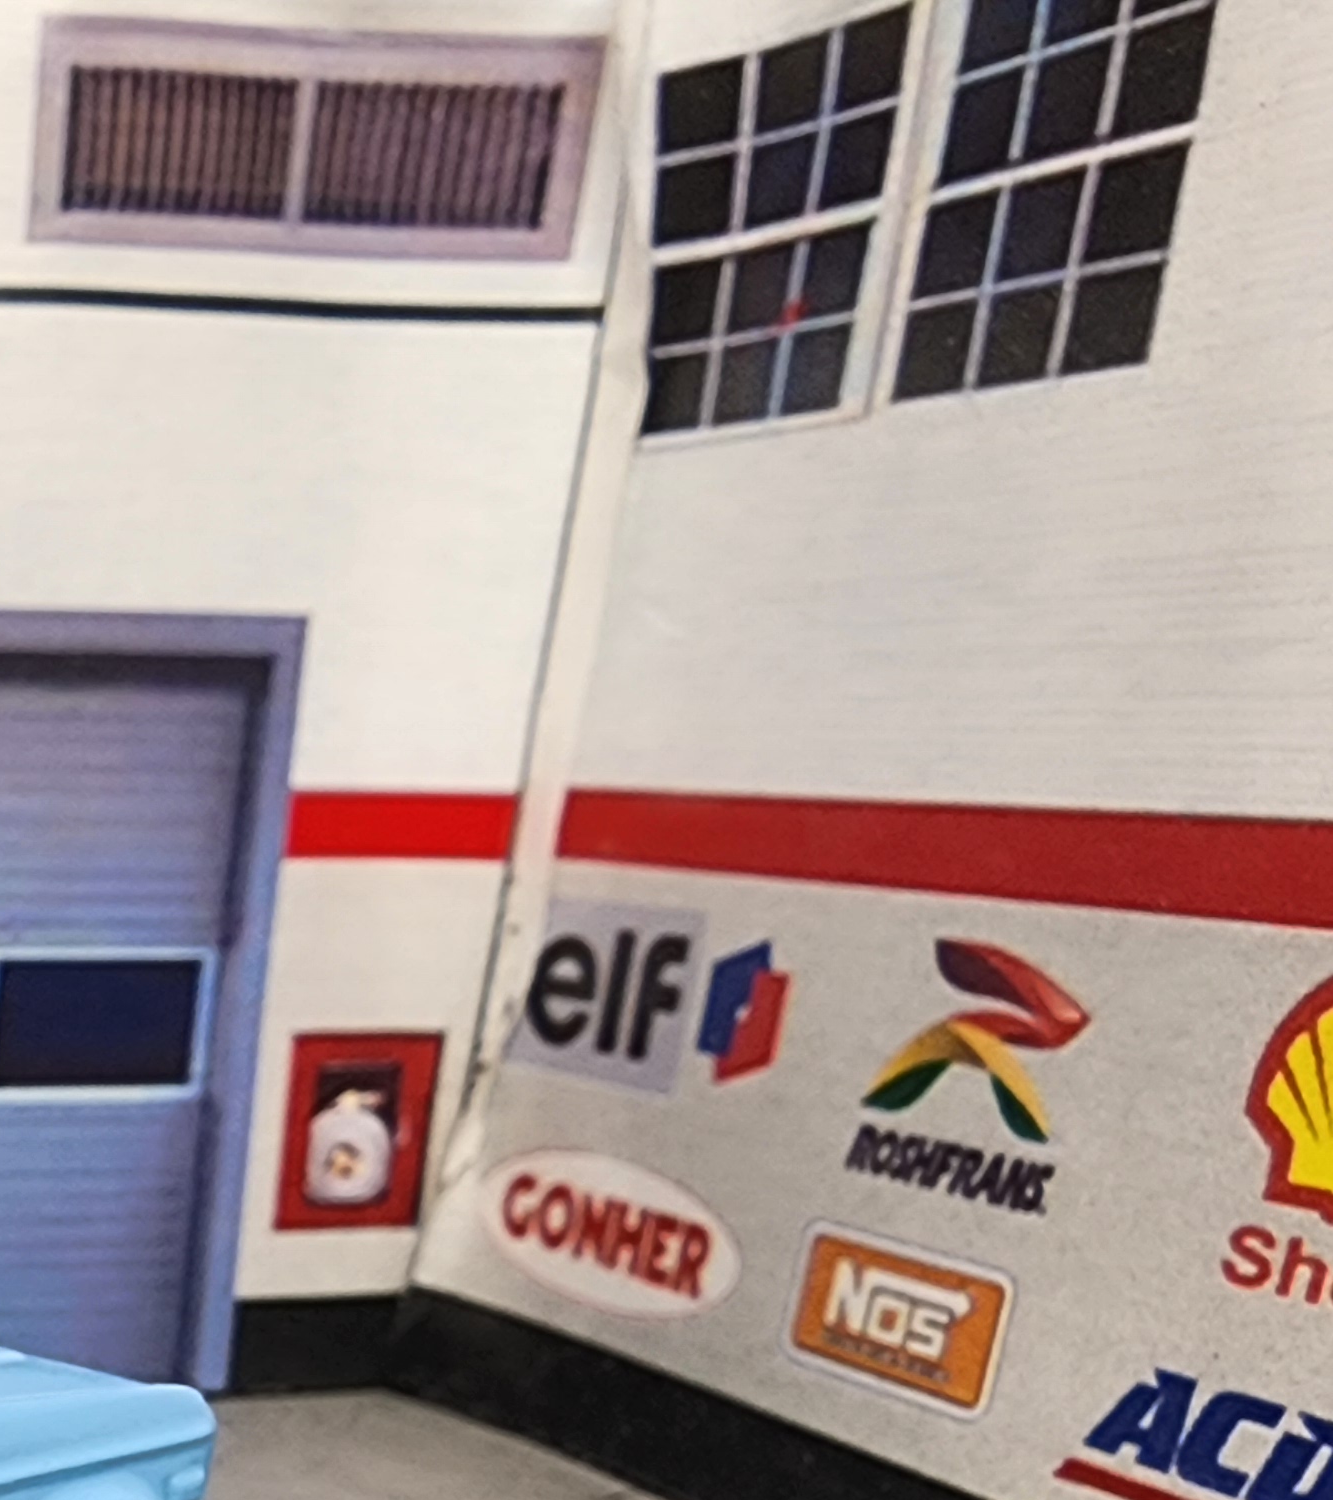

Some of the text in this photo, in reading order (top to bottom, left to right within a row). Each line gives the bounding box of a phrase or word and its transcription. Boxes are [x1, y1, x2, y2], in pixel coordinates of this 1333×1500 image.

[527, 930, 689, 1059] elf
[845, 1124, 1055, 1212] ROSHFRANS
[824, 1257, 971, 1362] NOS
[1221, 1225, 1333, 1305] Sh
